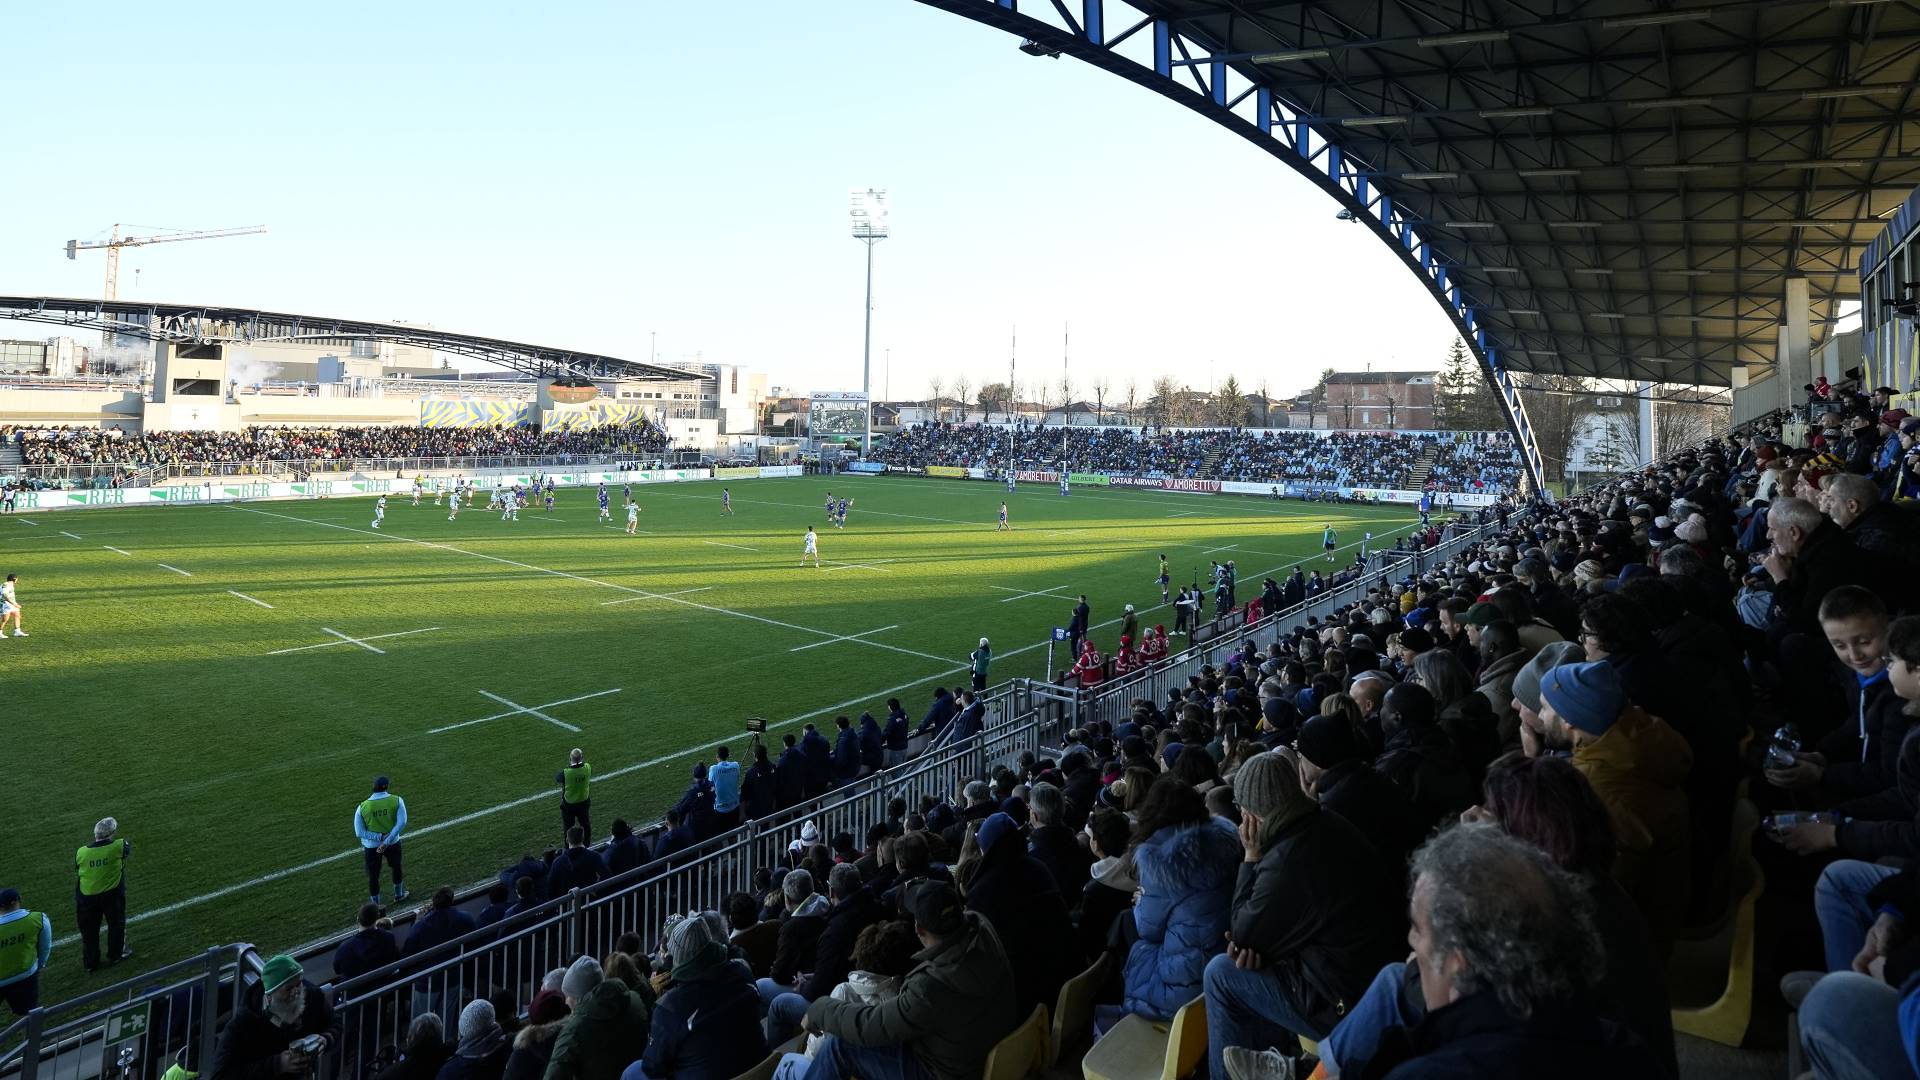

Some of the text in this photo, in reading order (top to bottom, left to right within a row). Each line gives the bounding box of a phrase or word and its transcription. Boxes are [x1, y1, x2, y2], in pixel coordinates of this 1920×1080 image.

[1020, 471, 1049, 481] AMORETTI
[1110, 476, 1163, 487] QATAR AIRWAYS
[1173, 479, 1210, 490] AMORETTI
